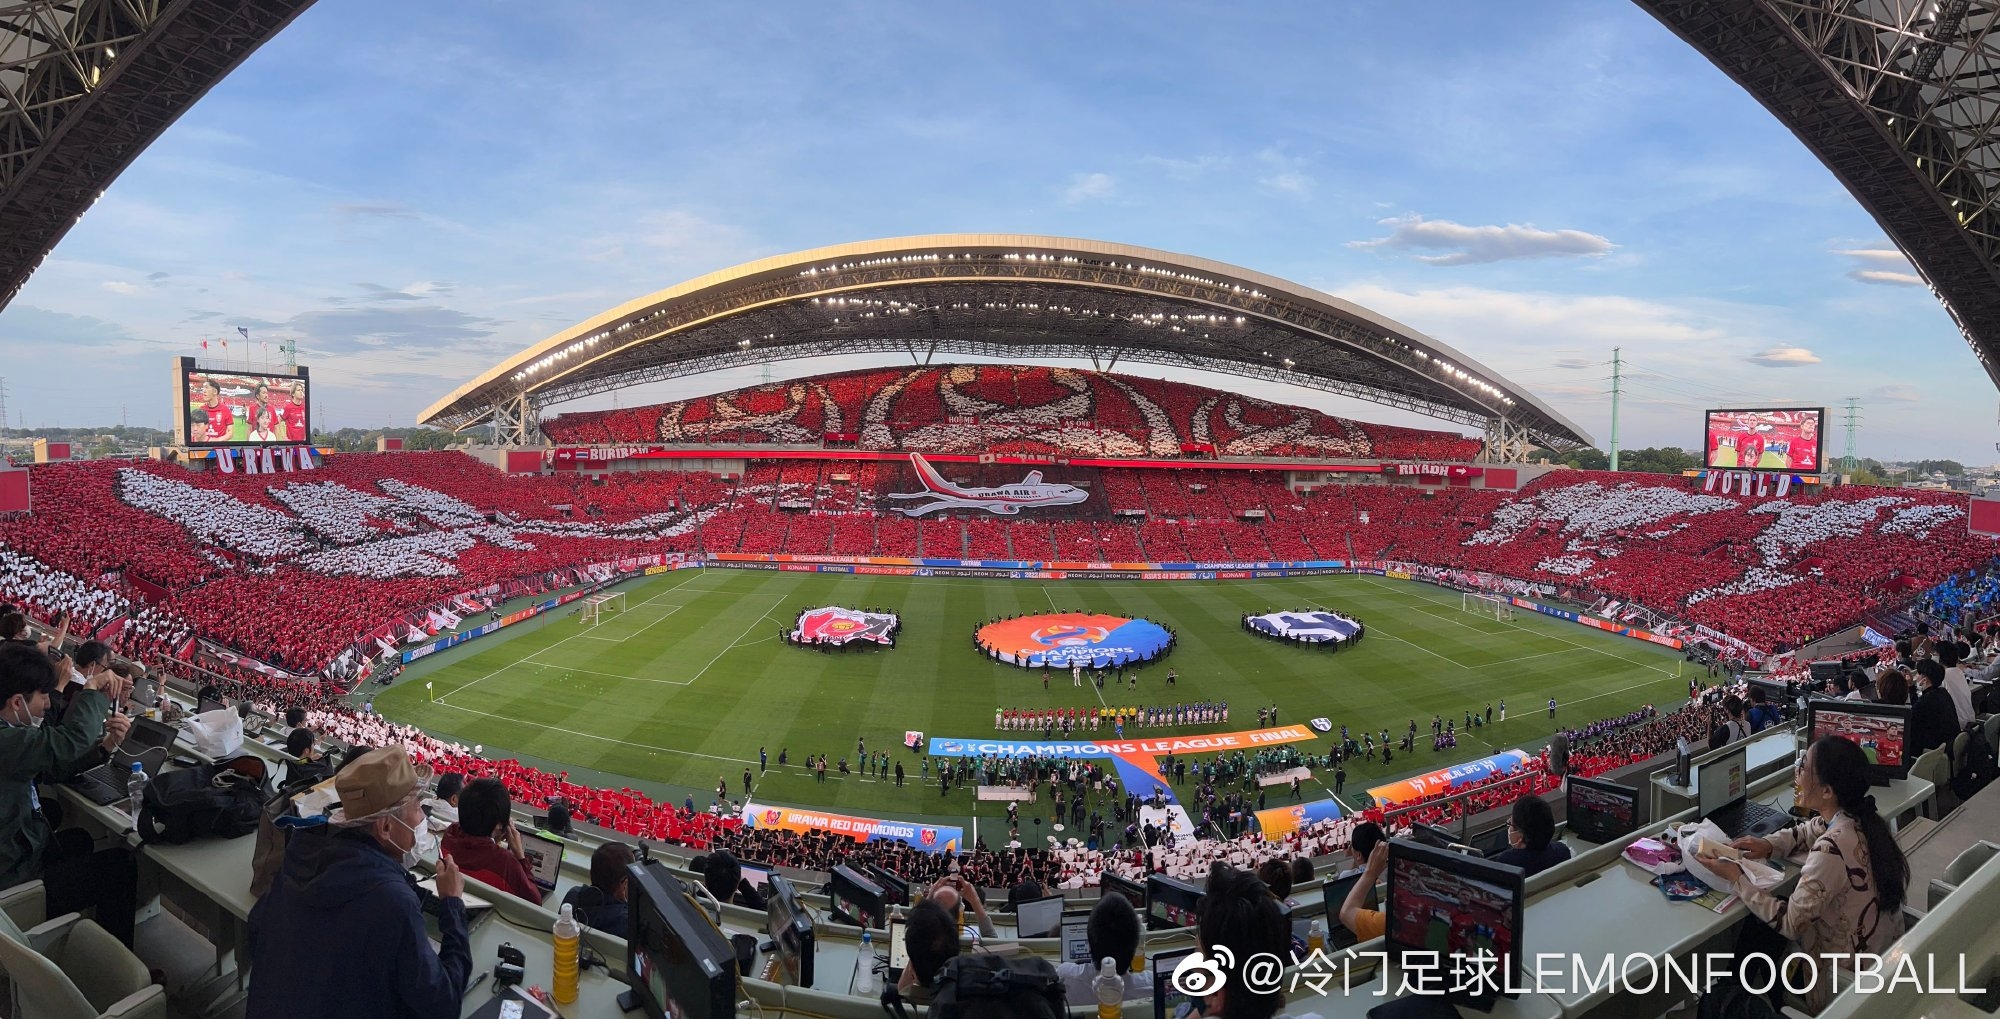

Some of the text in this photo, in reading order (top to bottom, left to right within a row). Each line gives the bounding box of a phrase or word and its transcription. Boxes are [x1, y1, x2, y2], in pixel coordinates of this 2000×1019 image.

[216, 447, 314, 475] URAWA
[1399, 463, 1449, 477] RIYADH
[978, 490, 1011, 498] URAWA
[1704, 470, 1791, 497] WORLD
[978, 729, 1306, 755] CHAMPIONS LEAGUE FINAL
[1429, 764, 1481, 785] AL HILAL SFC
[787, 812, 914, 838] URAWA RED DIAMONDS
